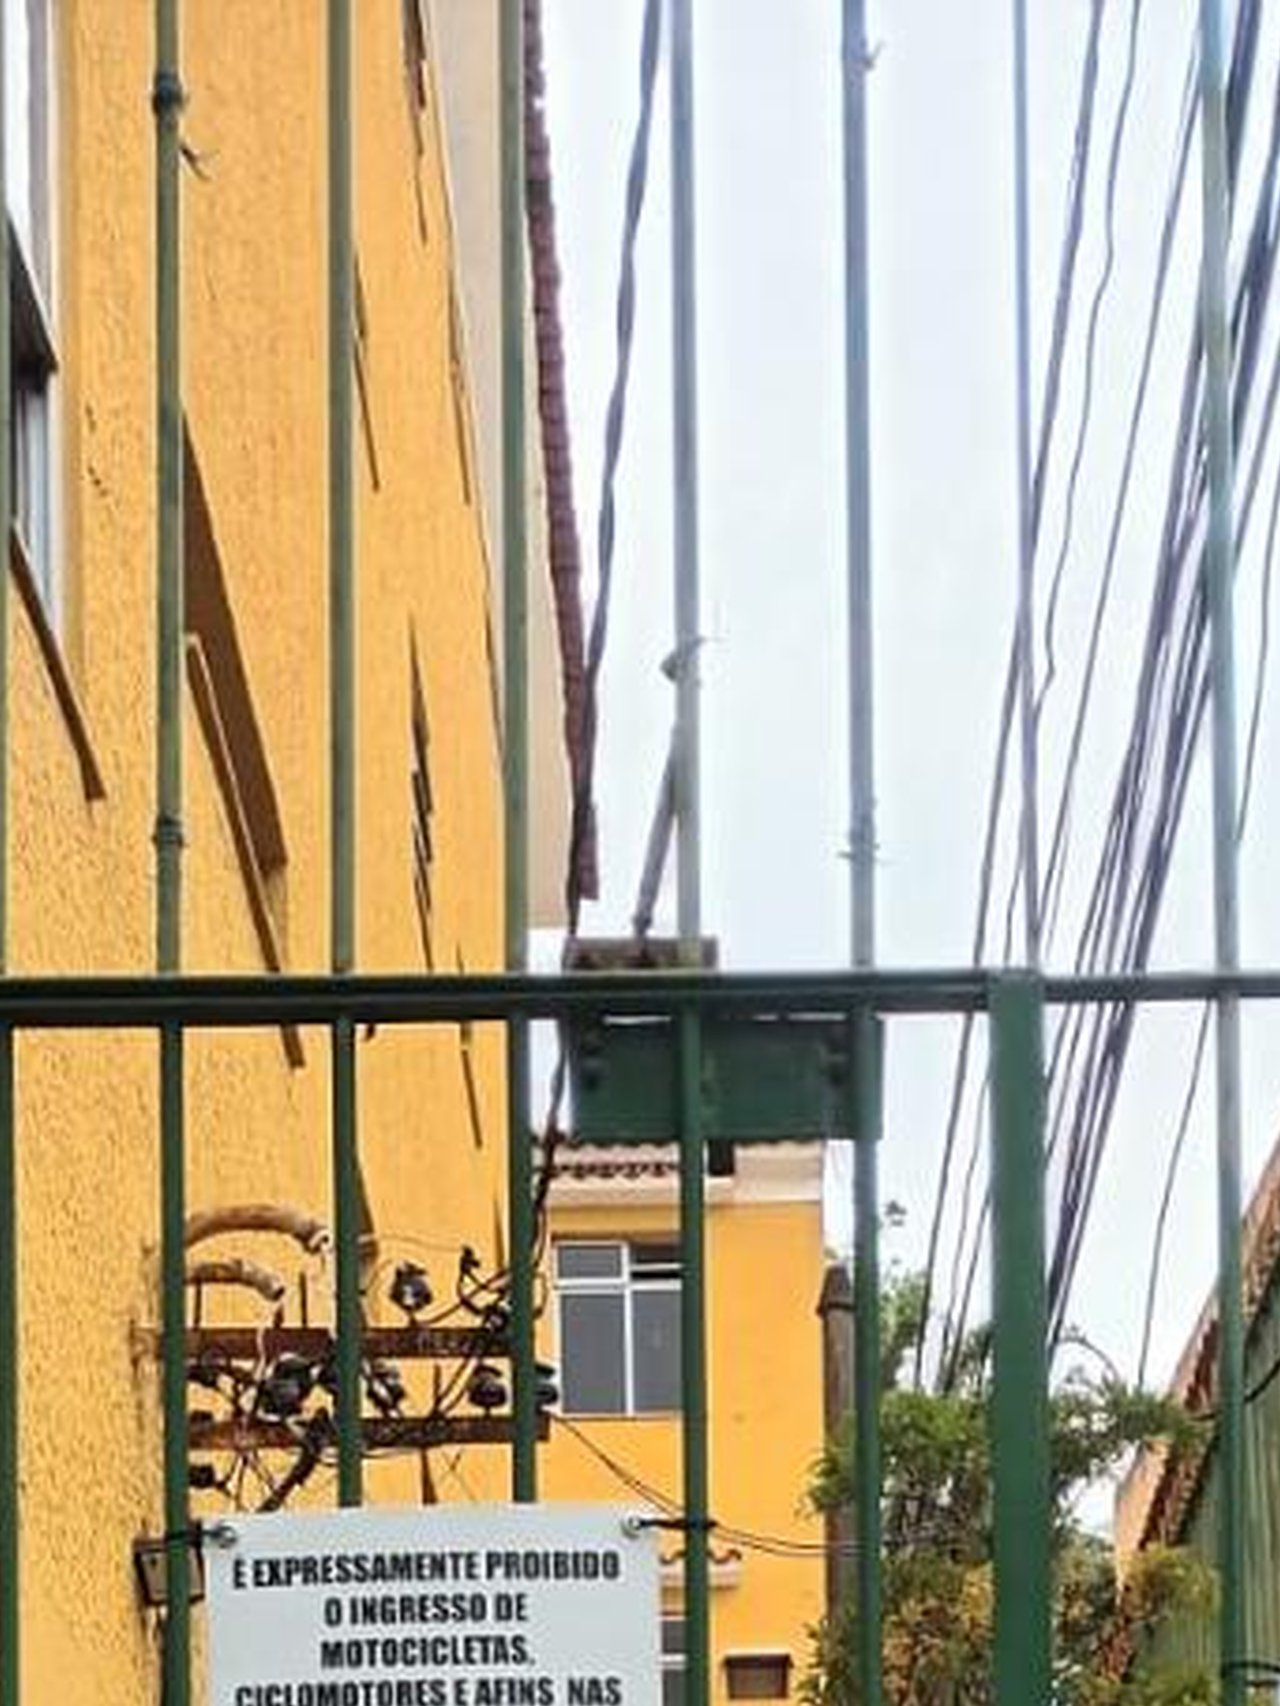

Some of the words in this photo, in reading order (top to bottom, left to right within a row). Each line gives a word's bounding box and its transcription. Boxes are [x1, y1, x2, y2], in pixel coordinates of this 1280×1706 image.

[253, 1552, 478, 1587] EXPRESSAMENTE
[485, 1551, 620, 1580] PROIBIDO
[324, 1598, 342, 1627] O
[349, 1595, 487, 1625] INGRESSO
[494, 1593, 528, 1623] DE
[474, 1677, 555, 1706] AFINS
[567, 1676, 622, 1706] NAS
